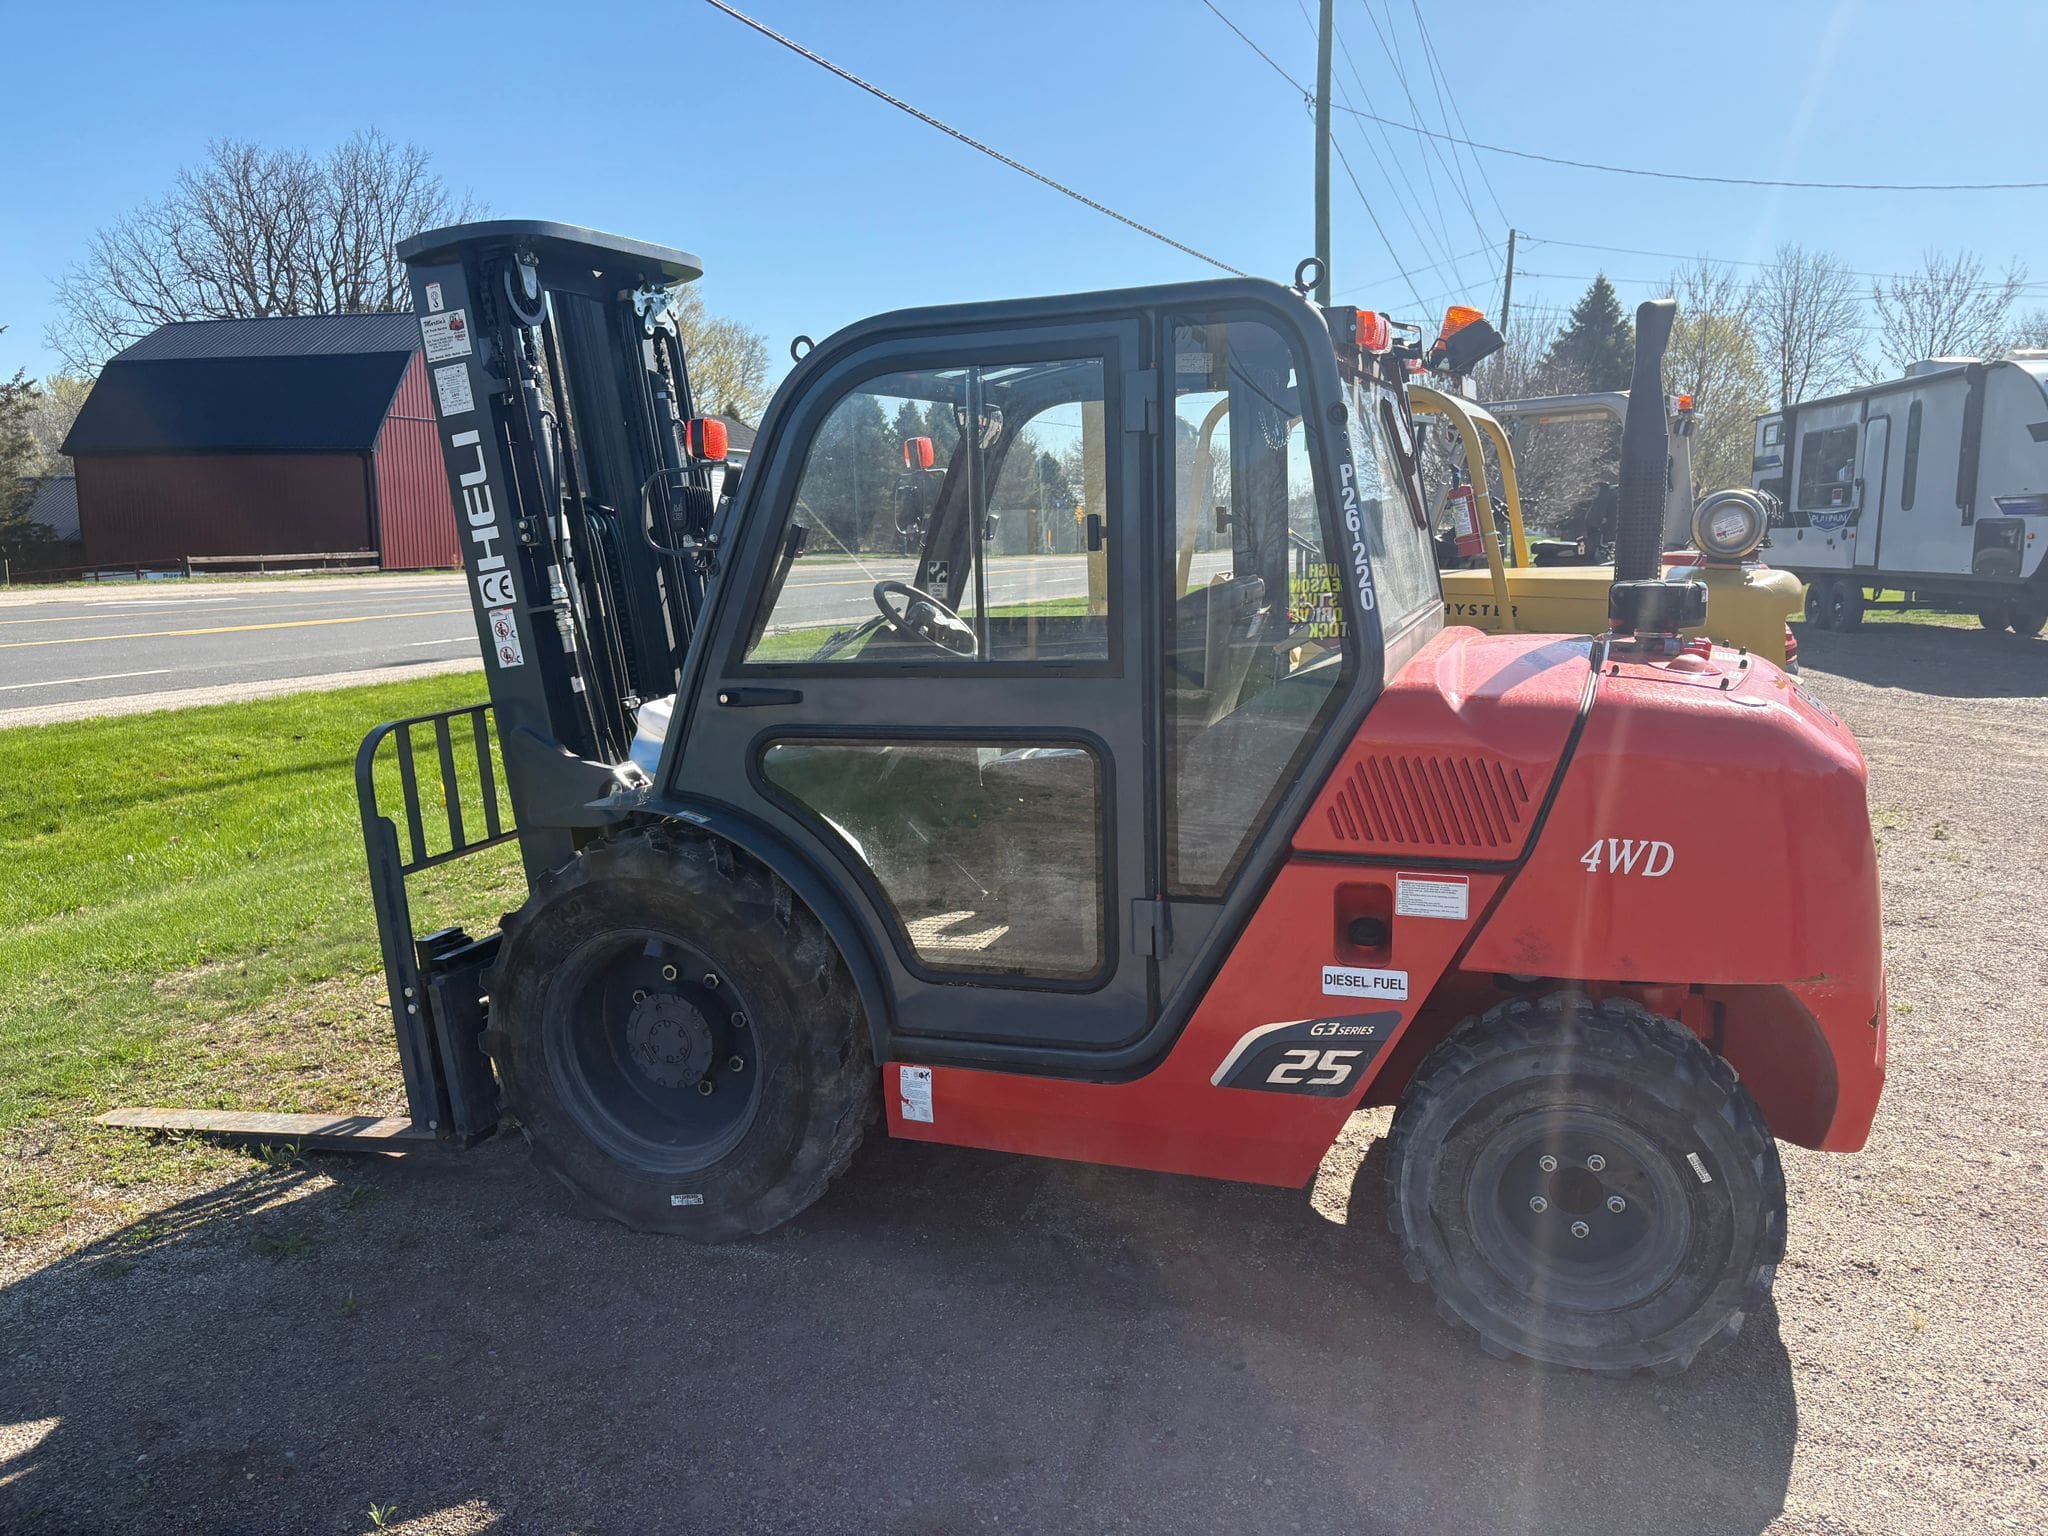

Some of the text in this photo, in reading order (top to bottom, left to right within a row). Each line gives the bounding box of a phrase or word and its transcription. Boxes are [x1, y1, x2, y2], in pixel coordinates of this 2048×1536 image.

[451, 429, 506, 572] HELI
[1340, 463, 1375, 611] P26-220
[1580, 838, 1675, 877] 4WD
[1324, 973, 1406, 991] DIESEL FUEL
[1265, 1049, 1364, 1085] 25
